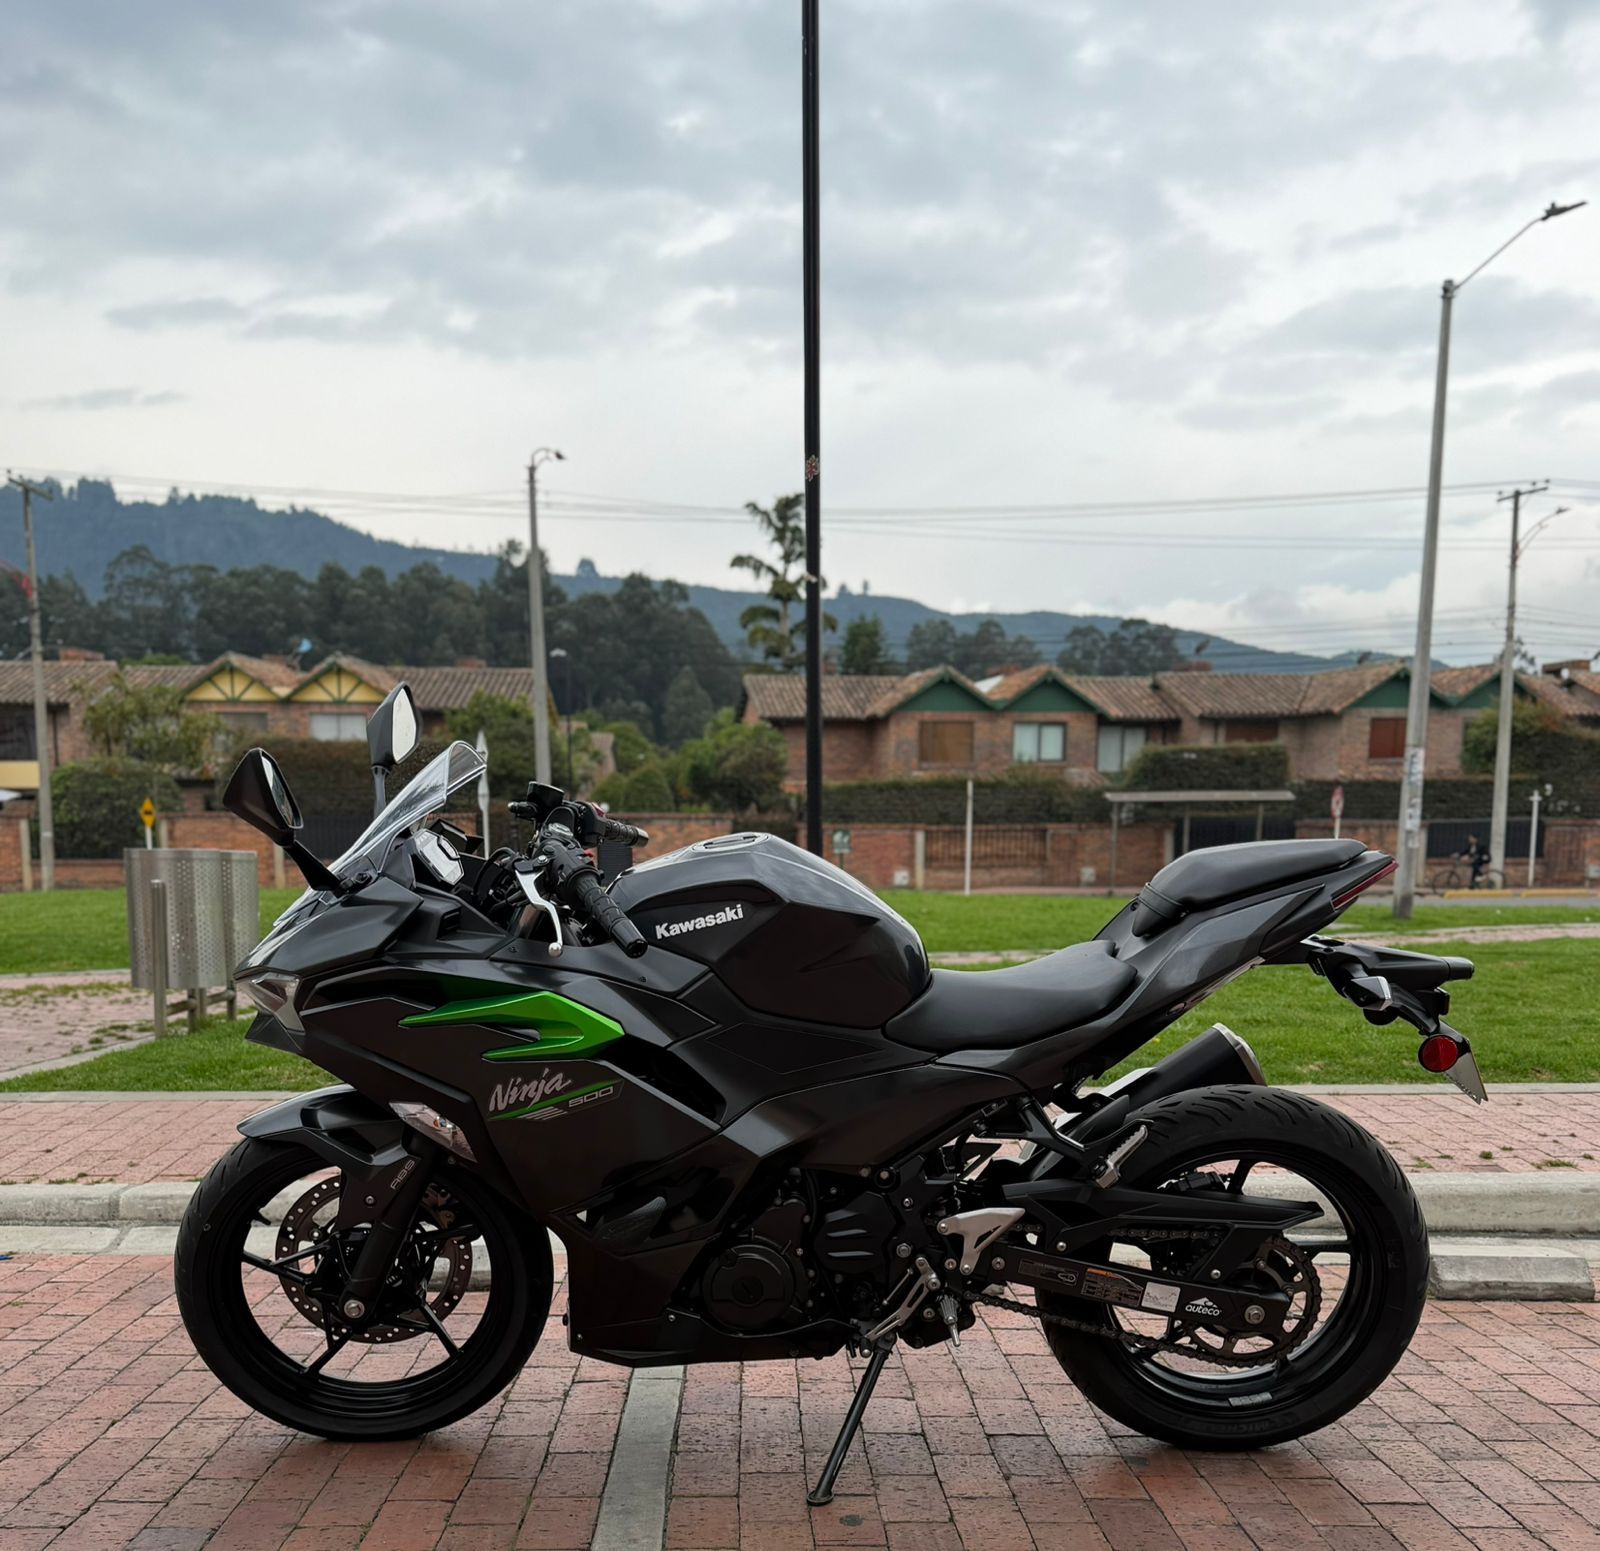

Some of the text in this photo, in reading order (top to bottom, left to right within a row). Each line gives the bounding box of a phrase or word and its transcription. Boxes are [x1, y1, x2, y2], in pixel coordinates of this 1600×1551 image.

[655, 903, 744, 939] Kawasaki
[489, 1068, 614, 1112] Ninja 500
[390, 1159, 415, 1190] ABS
[1184, 1304, 1220, 1317] auteco
